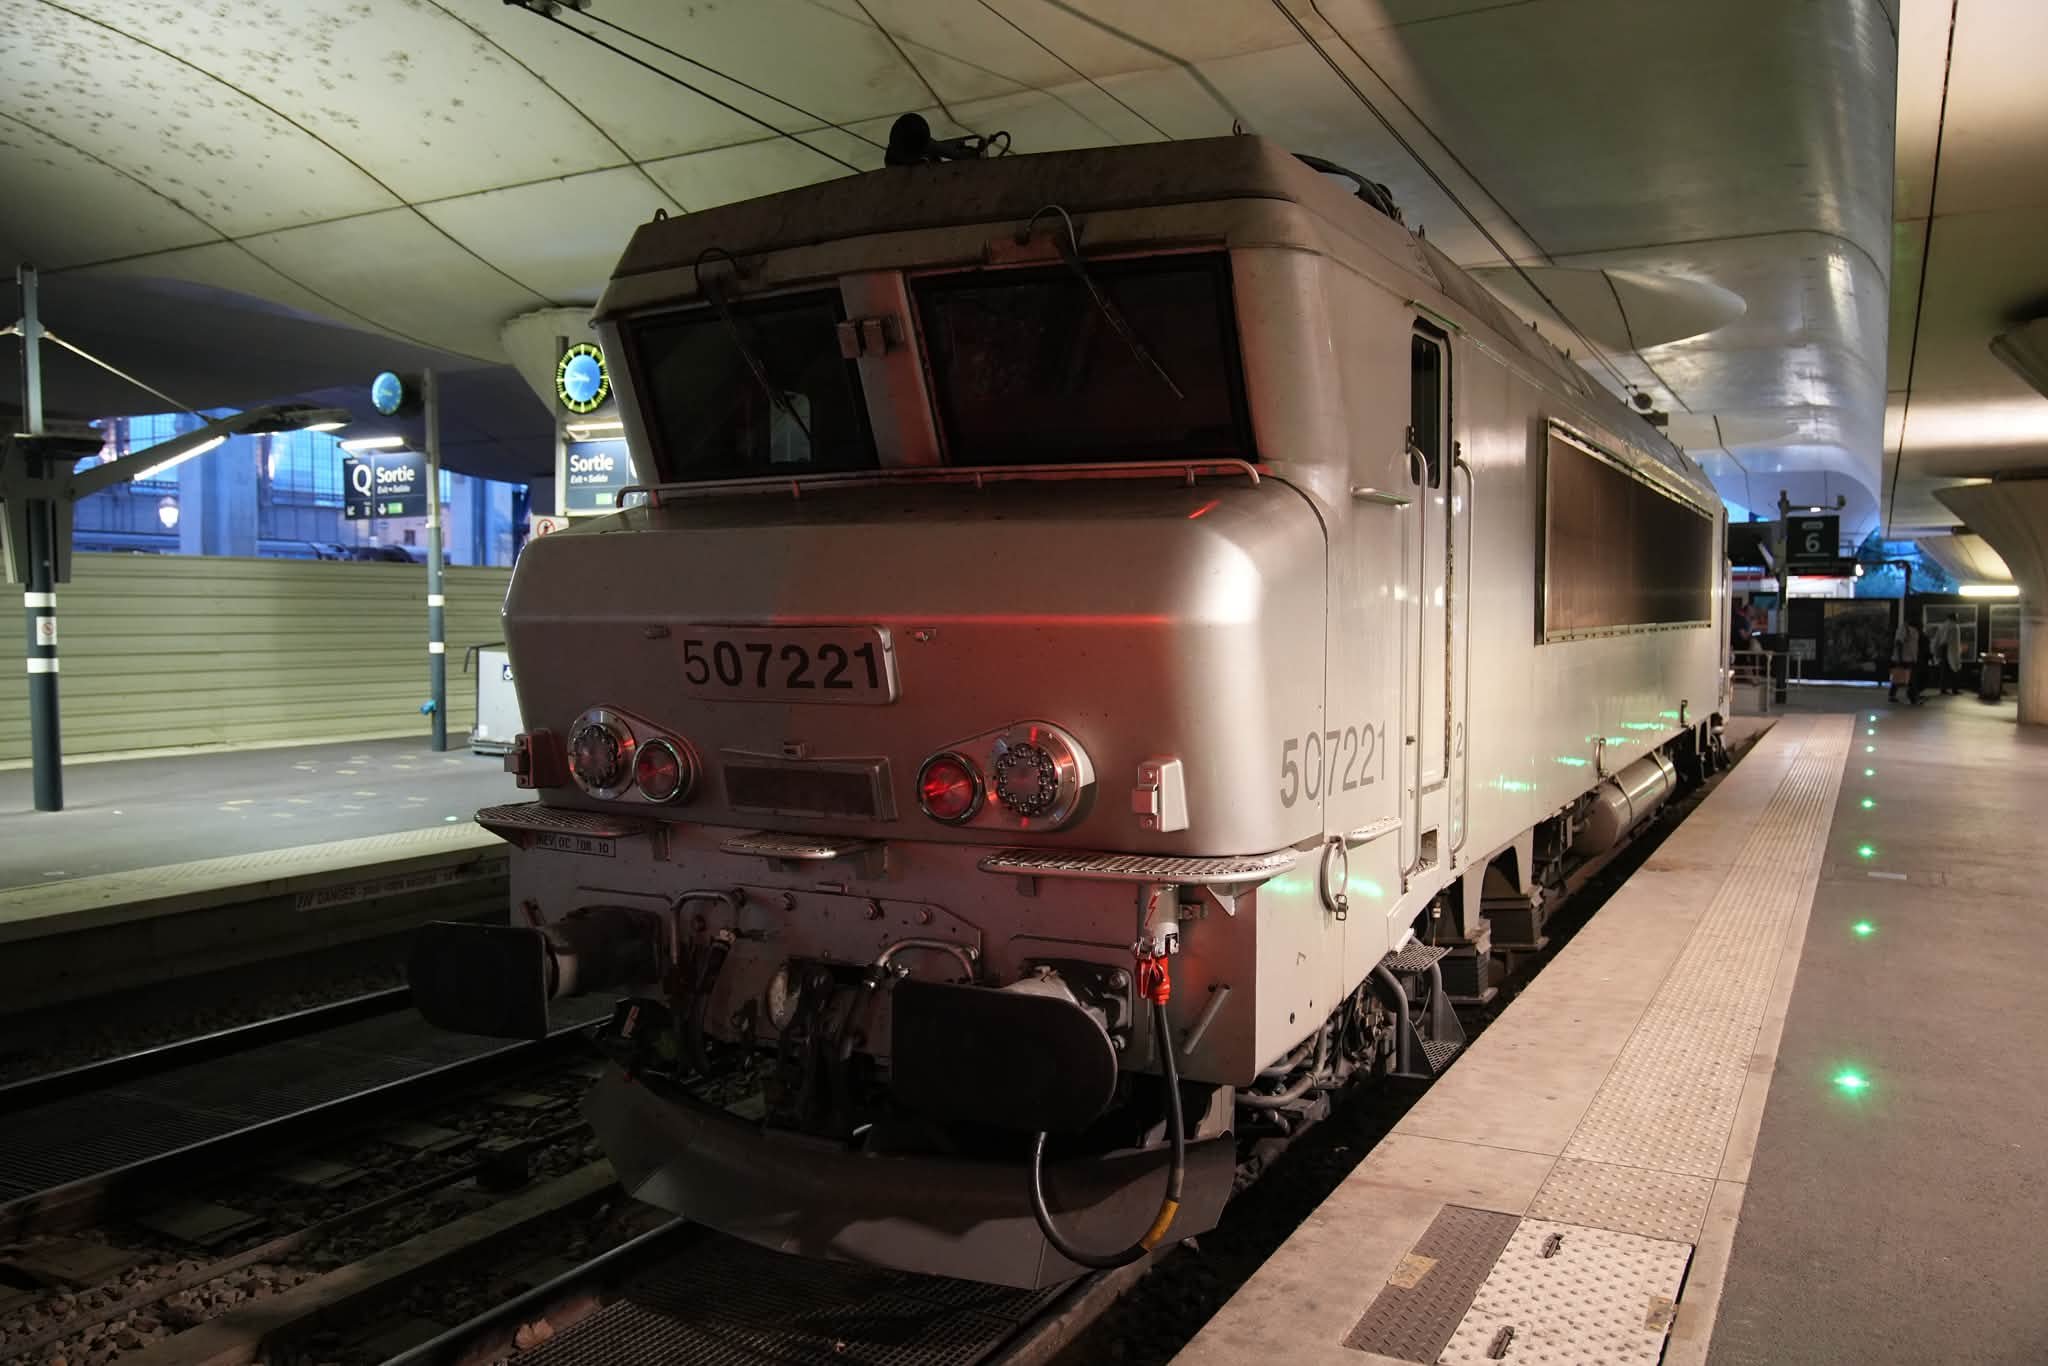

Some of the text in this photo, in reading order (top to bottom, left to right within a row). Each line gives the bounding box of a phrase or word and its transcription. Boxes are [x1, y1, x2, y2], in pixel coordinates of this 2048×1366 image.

[376, 465, 415, 483] Sortie
[570, 453, 614, 473] Sortie
[352, 464, 371, 496] Q
[1805, 532, 1820, 553] 6
[683, 639, 880, 690] 507221
[1279, 719, 1386, 809] 507221
